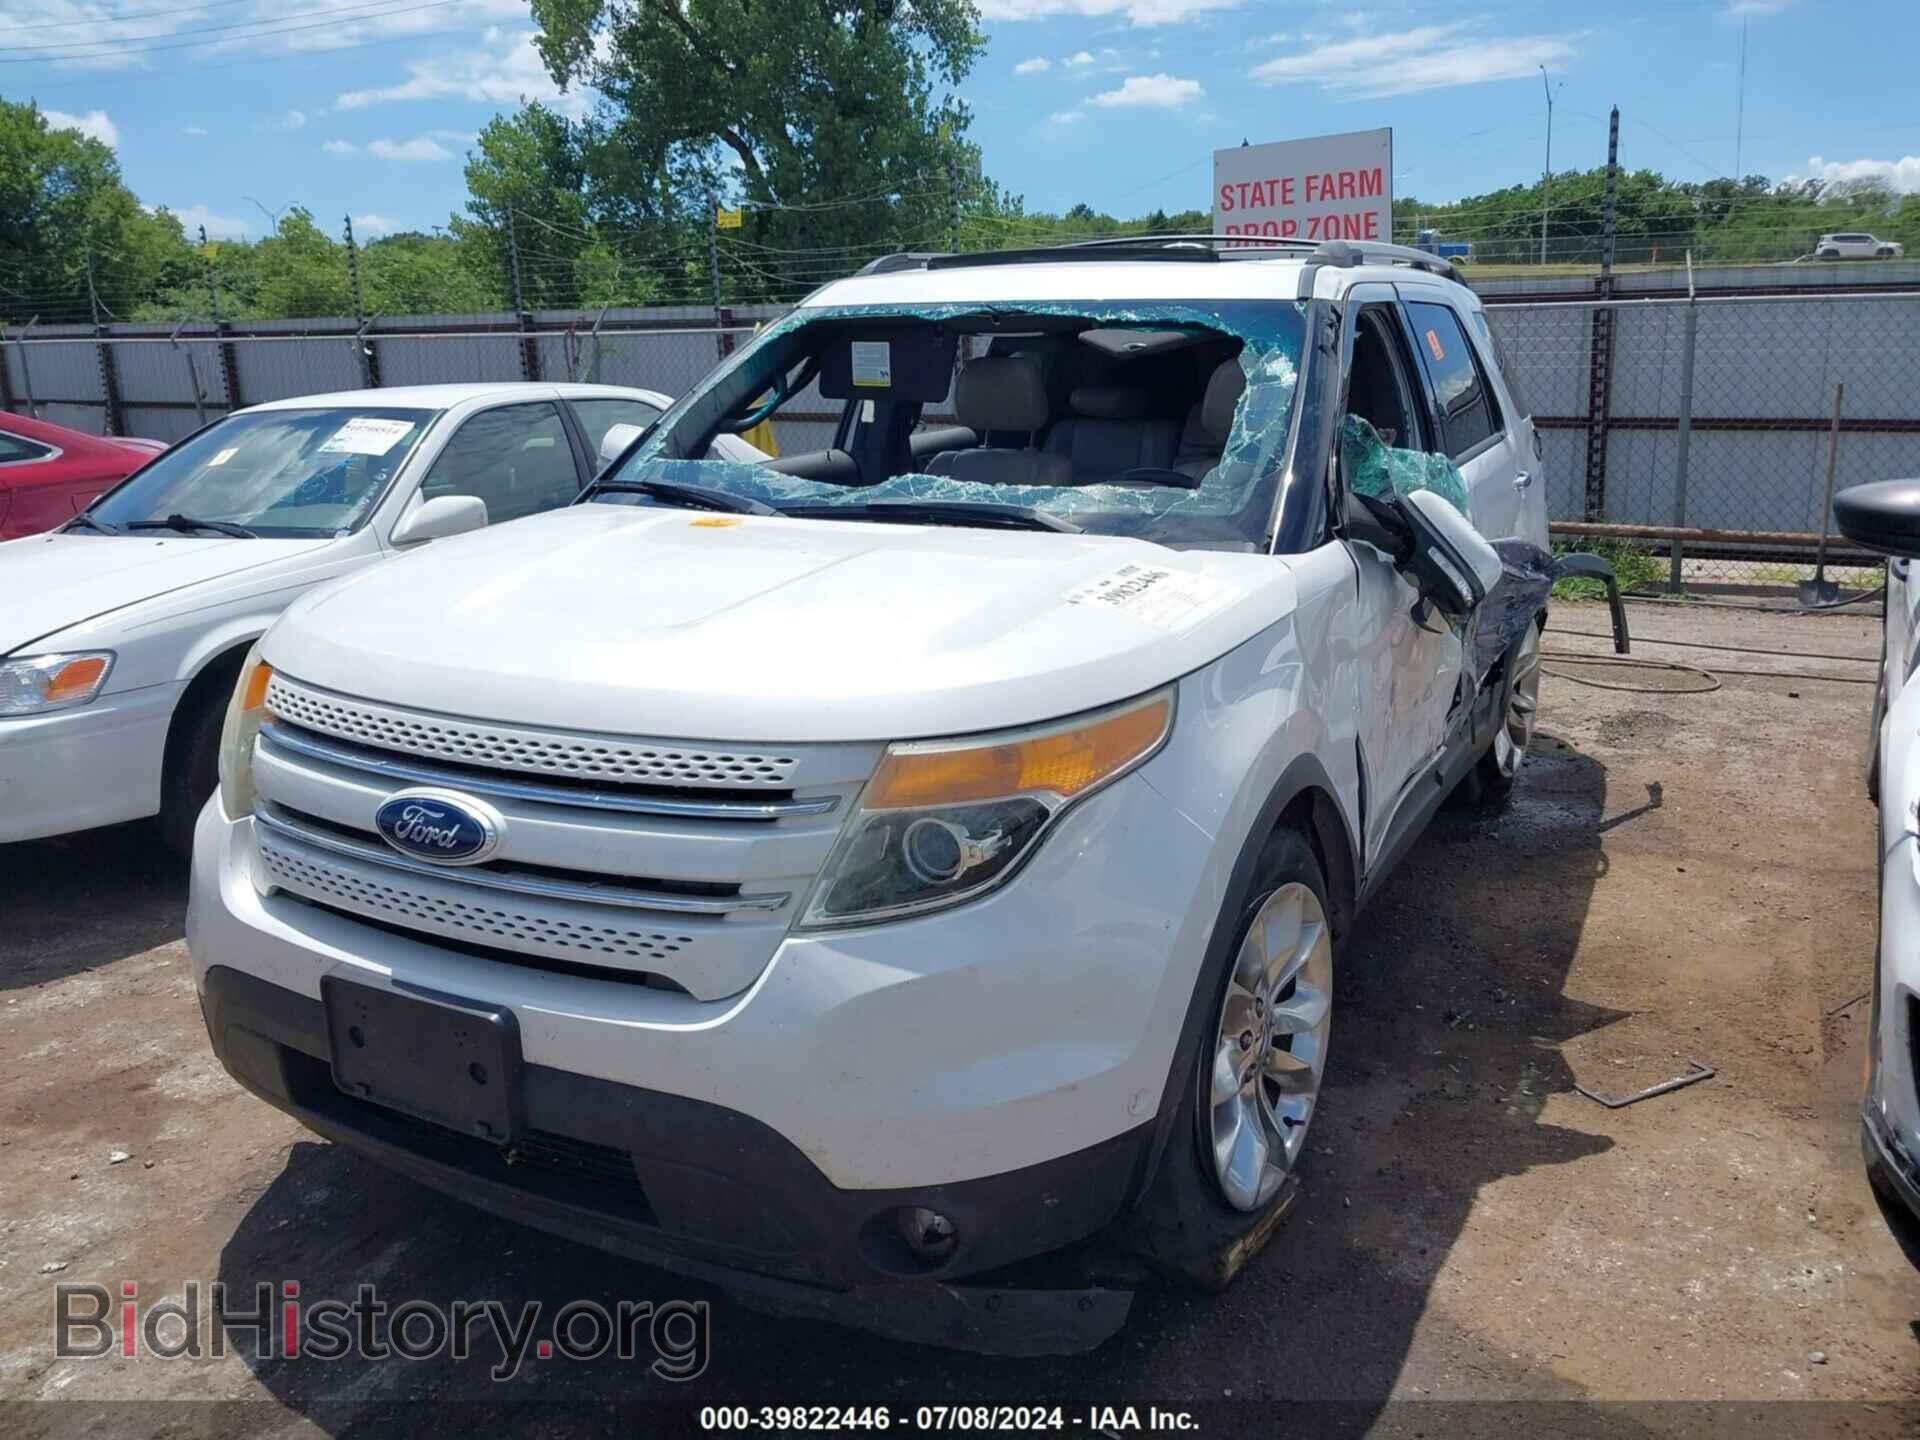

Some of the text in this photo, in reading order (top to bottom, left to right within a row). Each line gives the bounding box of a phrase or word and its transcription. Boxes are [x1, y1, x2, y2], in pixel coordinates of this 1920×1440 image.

[1220, 167, 1382, 212] STATE FARM
[1307, 211, 1379, 243] ZONE
[395, 805, 461, 848] Ford
